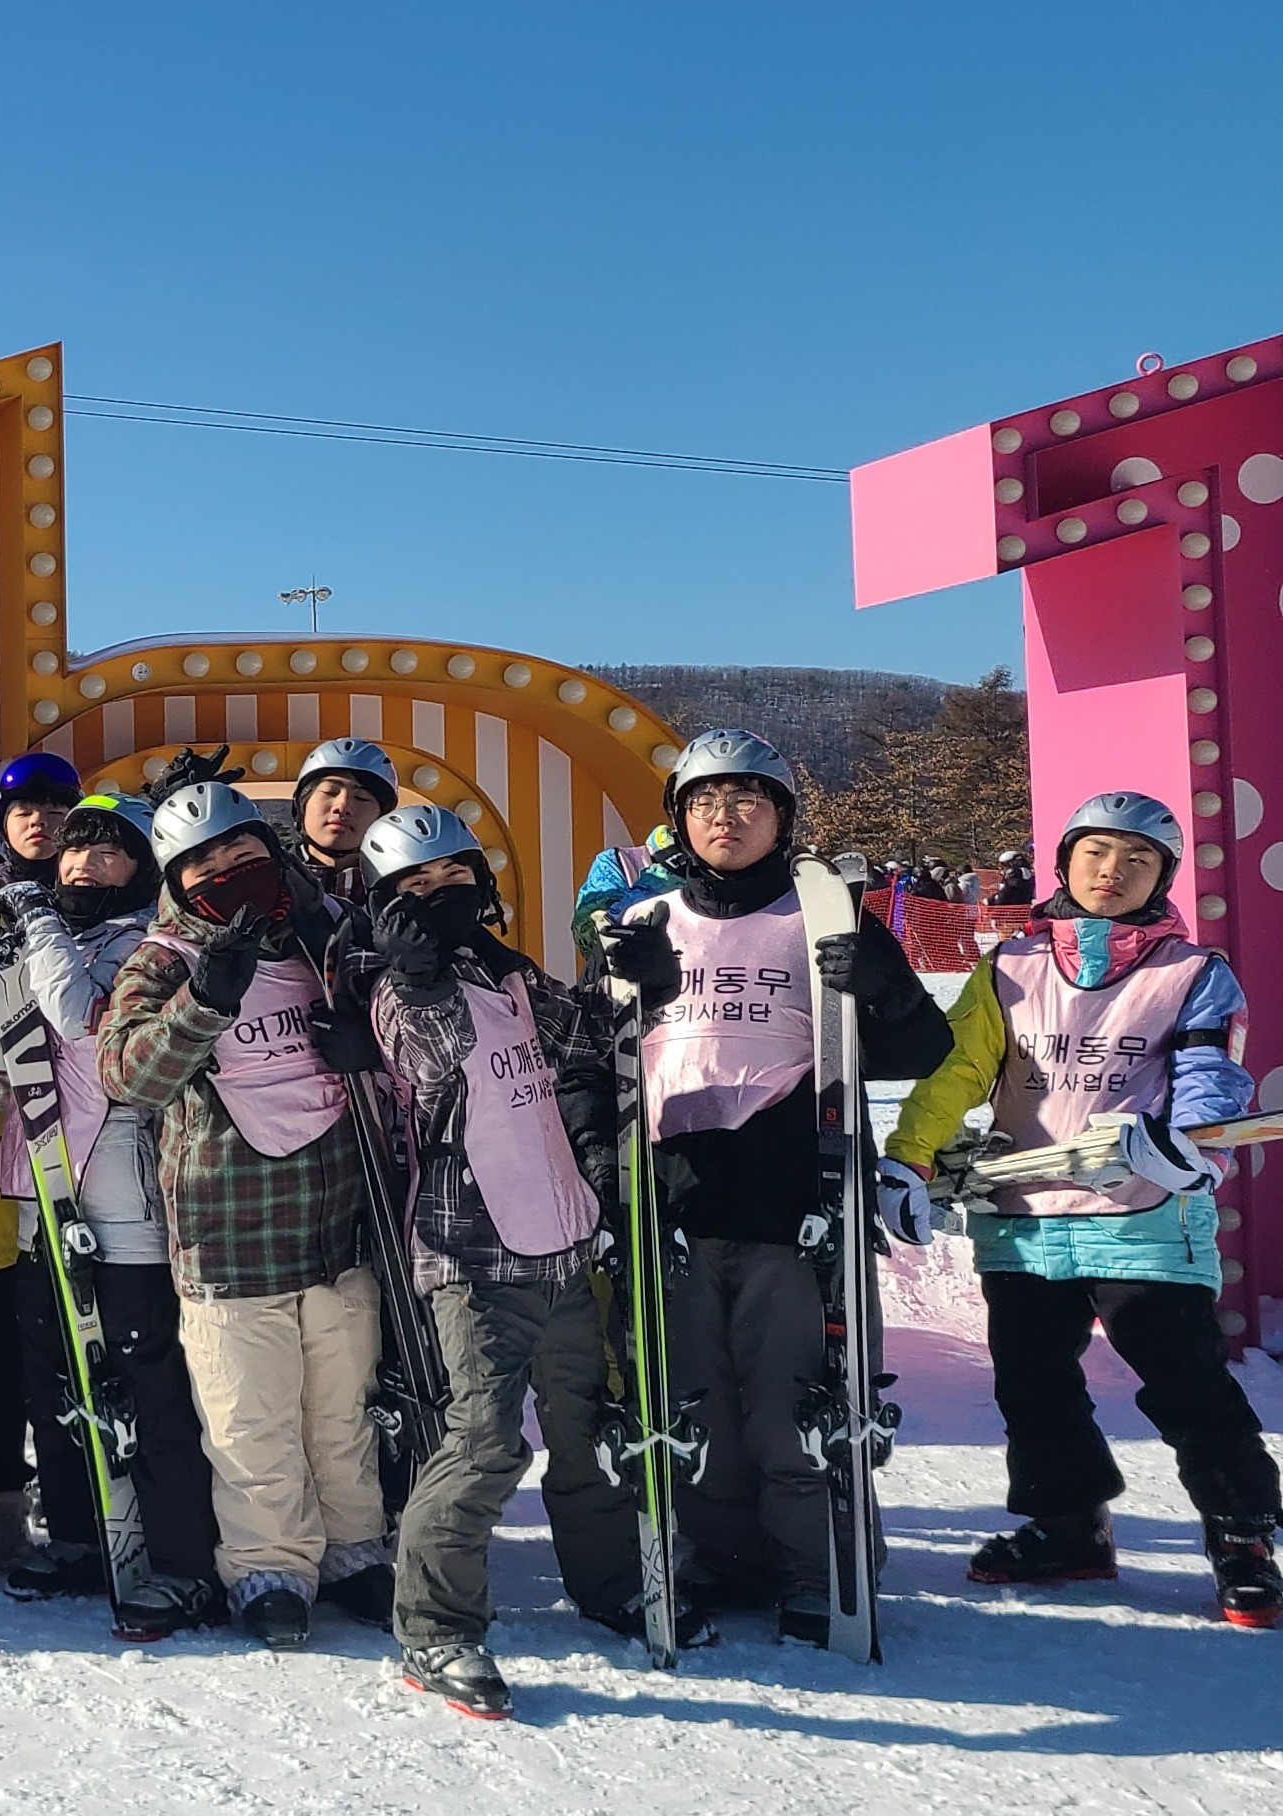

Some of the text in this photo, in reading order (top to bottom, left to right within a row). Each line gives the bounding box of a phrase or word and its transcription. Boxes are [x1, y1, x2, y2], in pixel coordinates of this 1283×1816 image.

[681, 966, 792, 996] 깨동무
[234, 998, 324, 1045] 어깨
[1018, 1033, 1148, 1066] 어깨동무
[1025, 1071, 1128, 1093] 스키사업단
